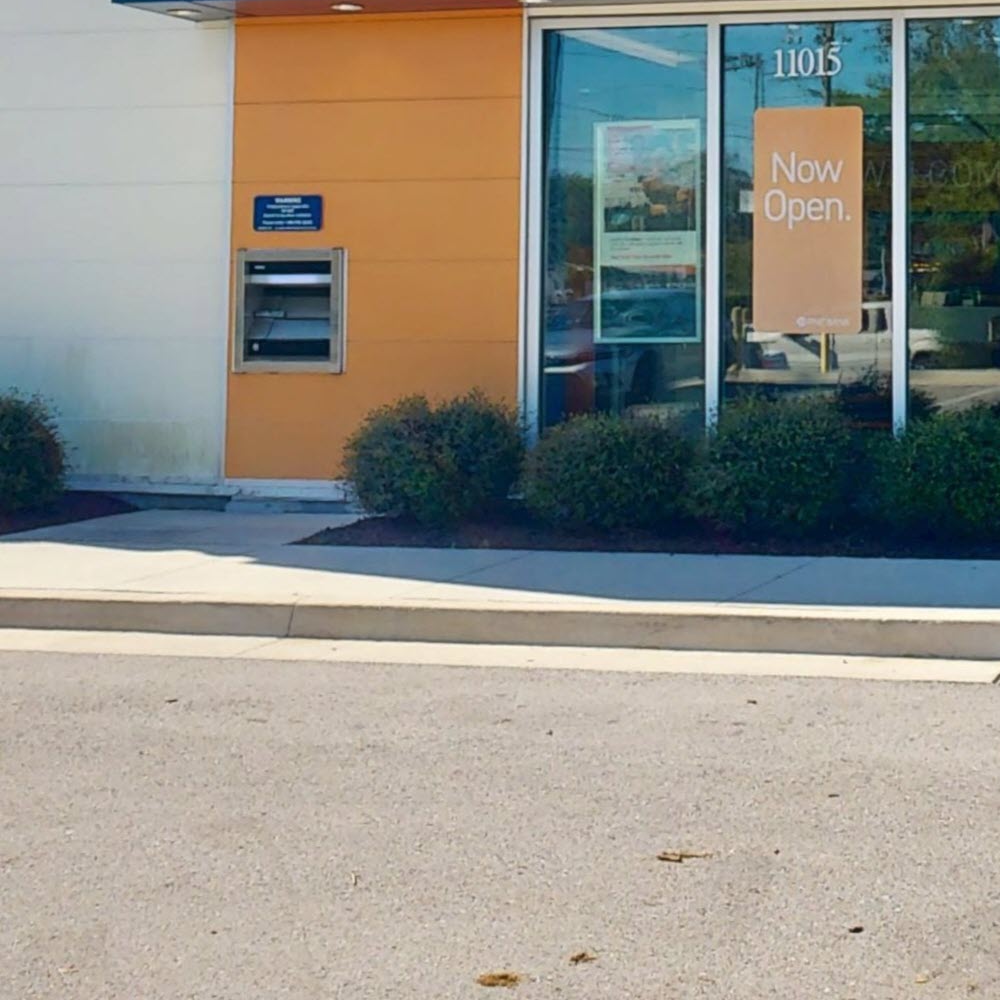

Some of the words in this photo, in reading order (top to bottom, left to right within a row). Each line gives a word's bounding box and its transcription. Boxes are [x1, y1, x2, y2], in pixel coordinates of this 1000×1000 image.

[773, 42, 842, 78] 11015
[771, 151, 844, 184] Now
[764, 189, 851, 230] Open.
